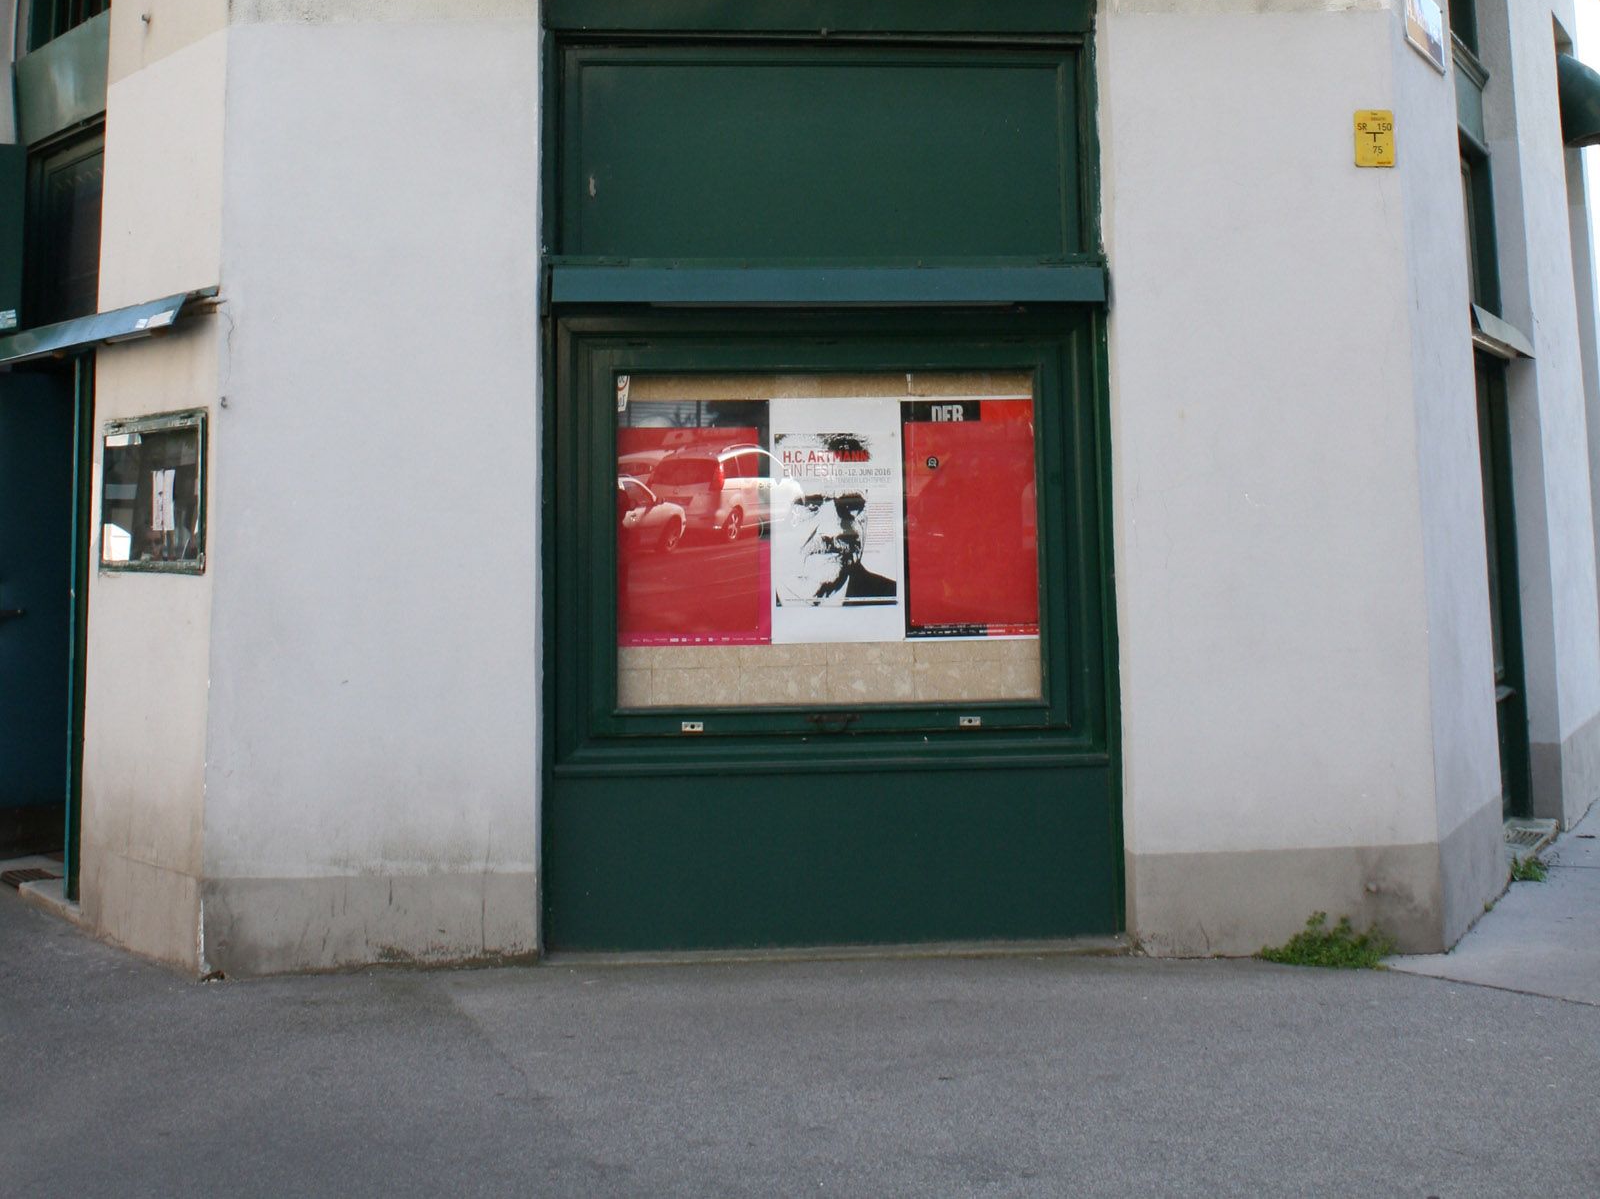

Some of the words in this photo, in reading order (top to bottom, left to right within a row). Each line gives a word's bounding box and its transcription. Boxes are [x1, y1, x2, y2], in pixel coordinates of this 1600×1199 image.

[1357, 123, 1367, 131] SR
[1377, 123, 1392, 131] 150
[1373, 145, 1383, 154] 75
[783, 450, 806, 463] H.C.
[807, 450, 871, 463] ARTMANN
[783, 464, 802, 477] EIN
[805, 463, 835, 477] FEST
